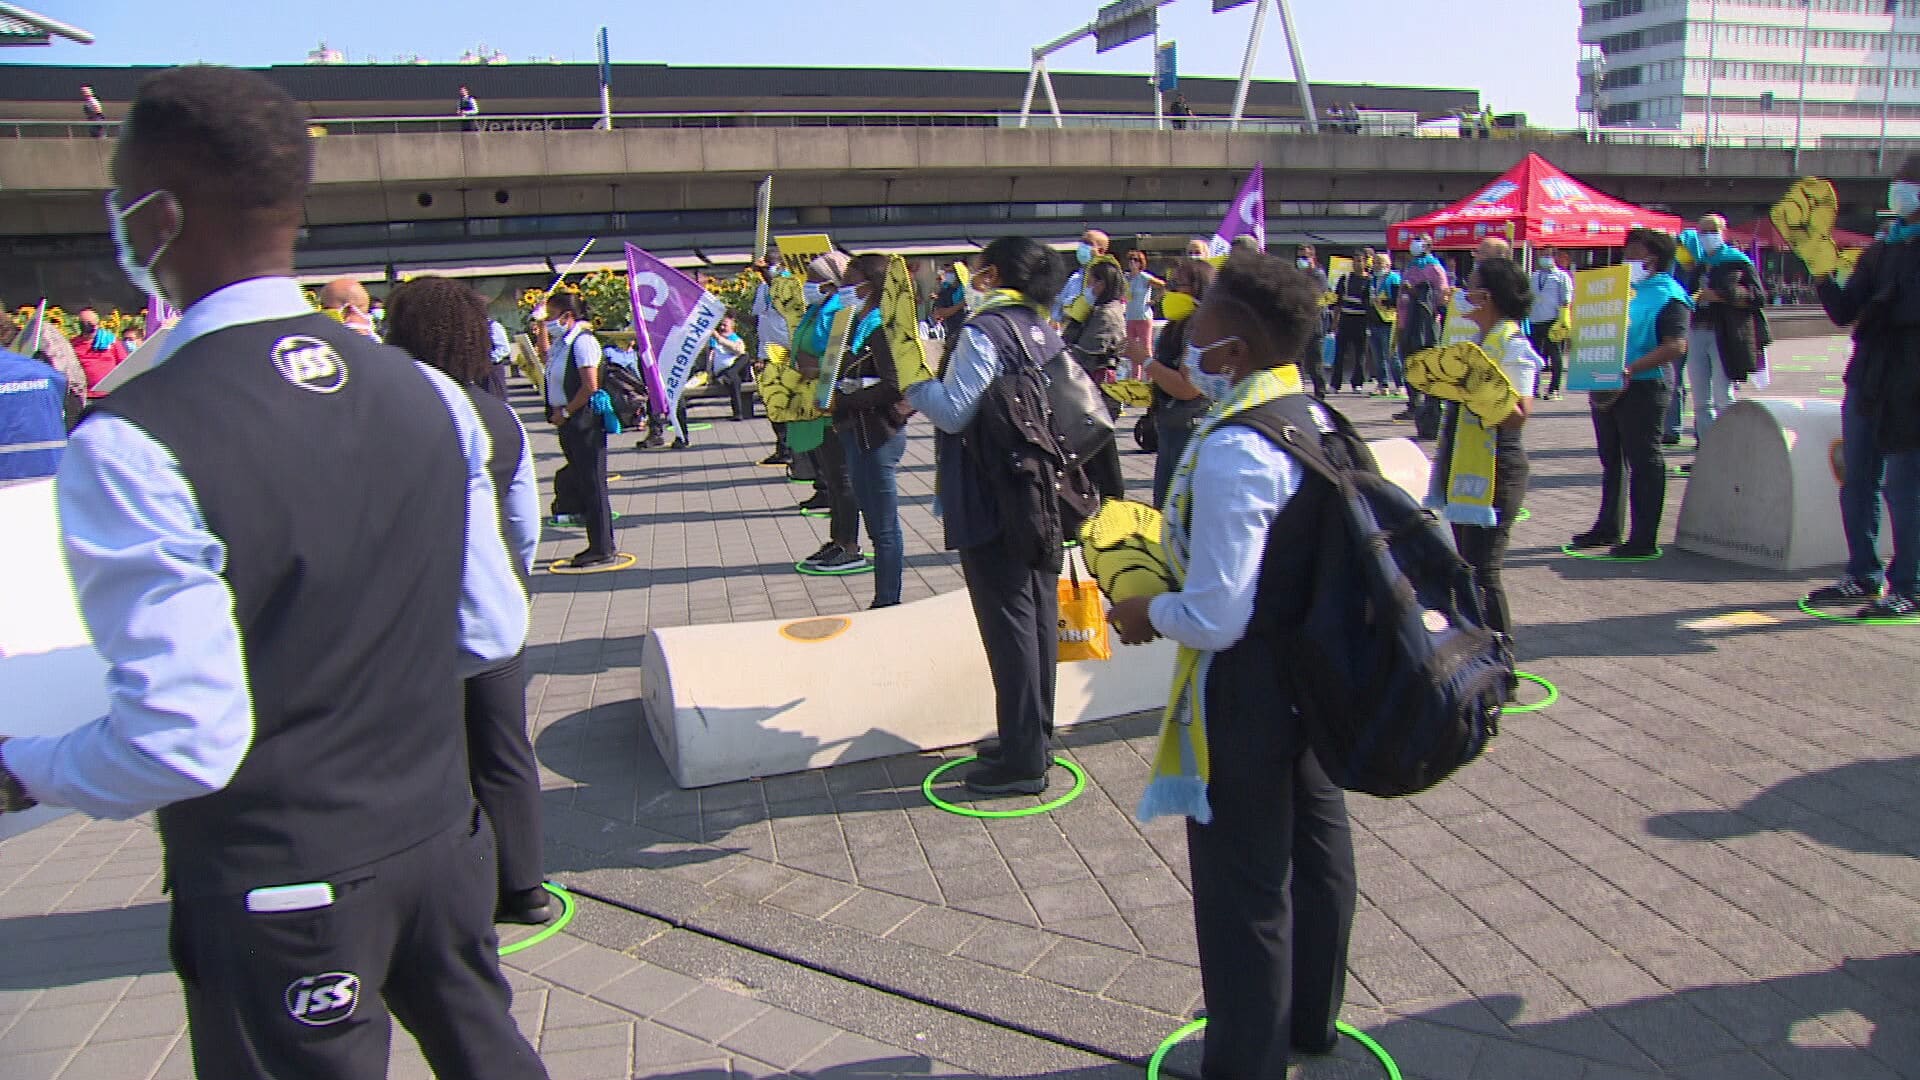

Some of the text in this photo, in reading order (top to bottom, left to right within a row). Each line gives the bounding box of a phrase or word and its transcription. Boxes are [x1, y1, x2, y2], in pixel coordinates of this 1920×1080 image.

[476, 119, 553, 132] Vertrek
[1587, 277, 1616, 296] NIET
[1577, 299, 1624, 319] MINDER
[1580, 323, 1617, 341] MAAR
[1577, 345, 1616, 363] MEER!
